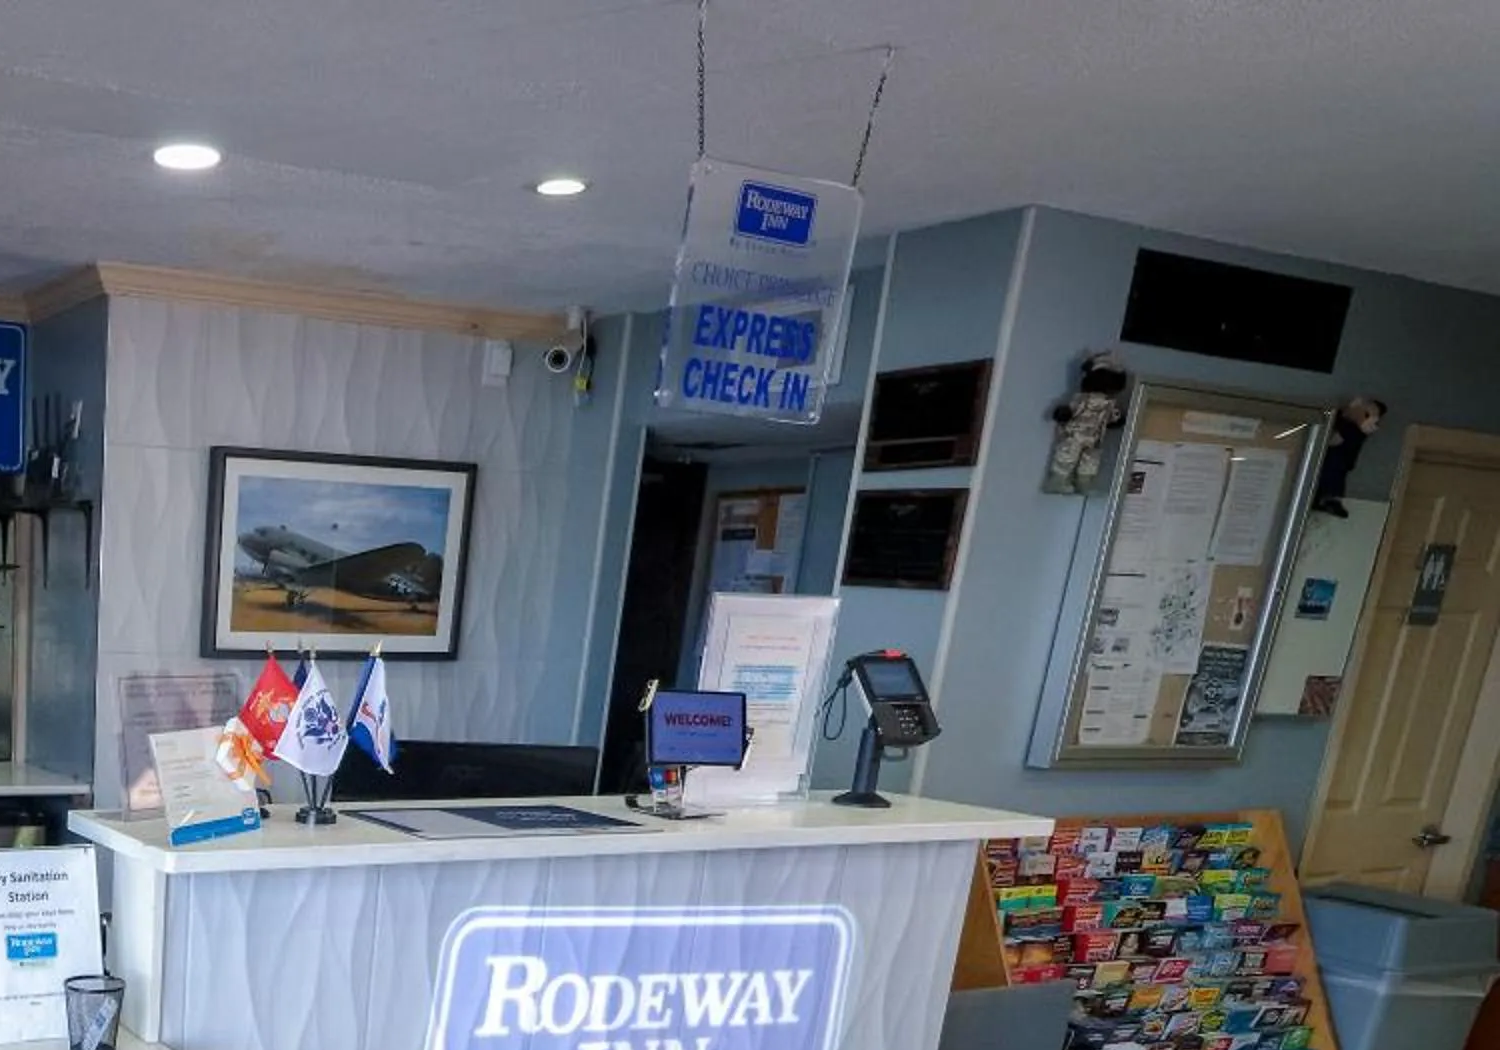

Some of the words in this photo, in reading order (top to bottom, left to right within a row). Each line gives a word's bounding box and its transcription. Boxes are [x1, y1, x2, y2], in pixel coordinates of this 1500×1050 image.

[746, 190, 809, 220] RODEWAY
[760, 213, 788, 231] INN
[693, 304, 815, 363] EXPRESS
[682, 357, 776, 408] CHECK
[778, 370, 810, 412] IN
[10, 868, 70, 884] Sanitation
[8, 890, 49, 903] Station
[474, 953, 814, 1038] RODEWAY
